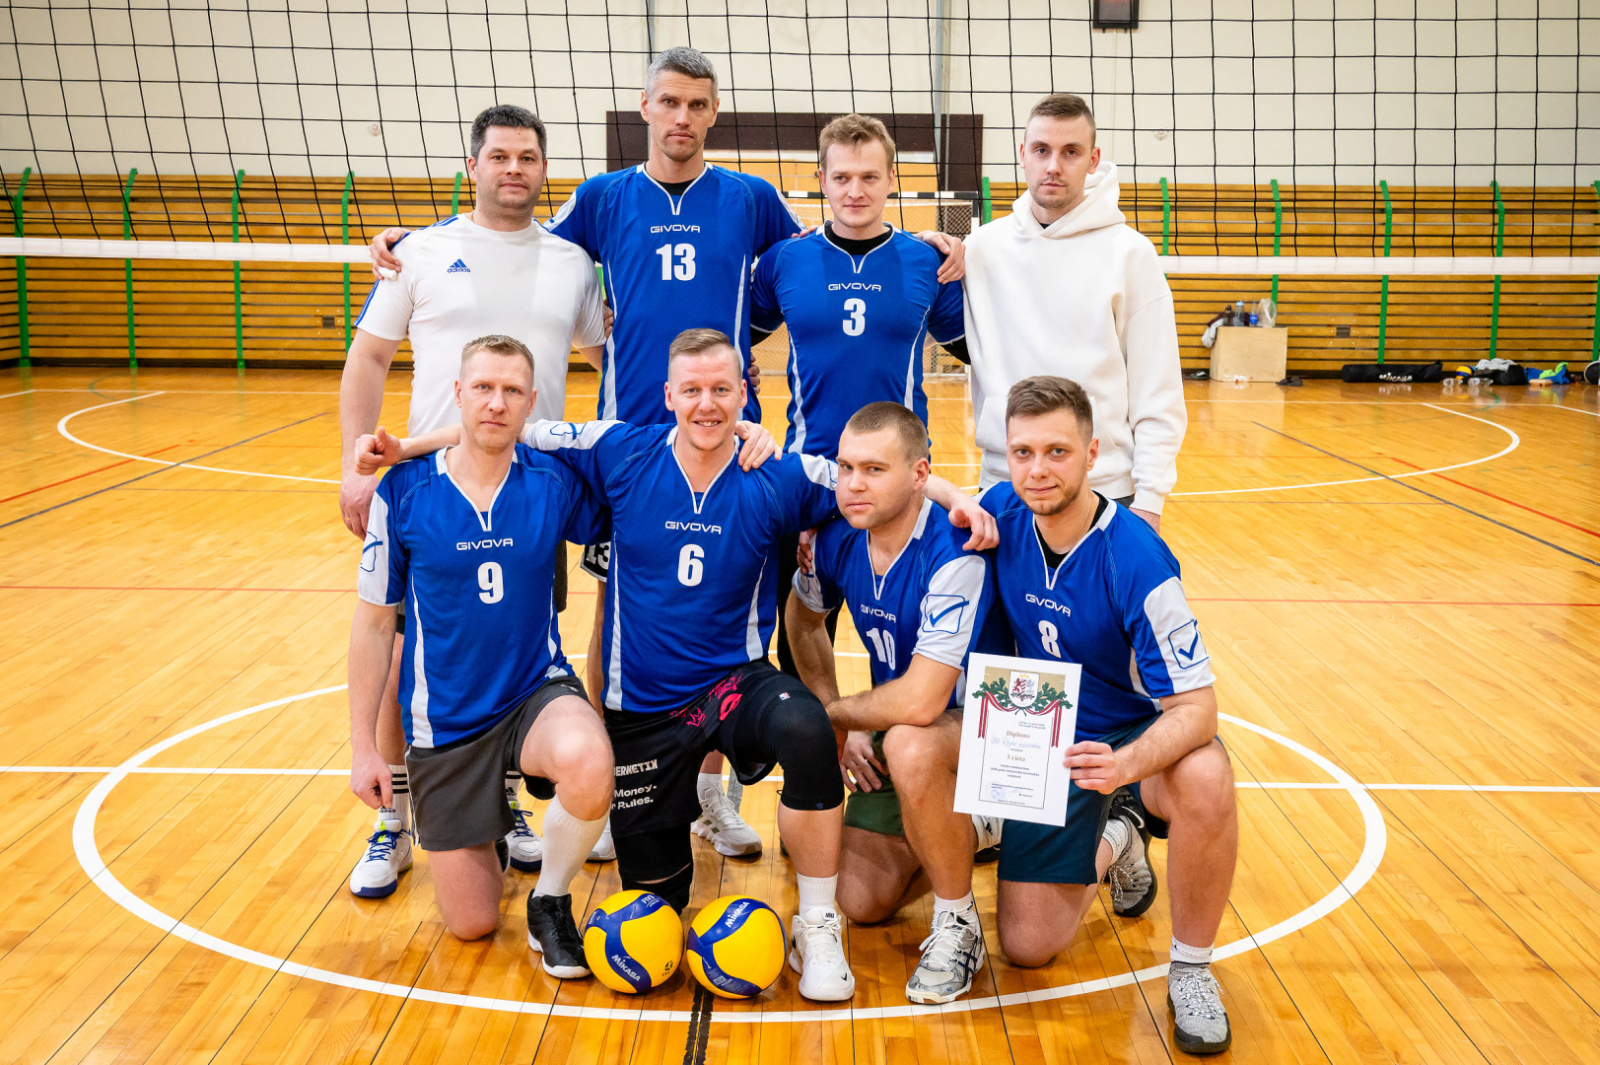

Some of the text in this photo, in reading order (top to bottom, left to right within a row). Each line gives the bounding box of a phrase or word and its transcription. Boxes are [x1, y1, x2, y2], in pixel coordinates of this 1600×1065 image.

[650, 224, 701, 234] GIVOVA
[656, 243, 696, 281] 13
[828, 282, 882, 292] GIVOVA
[842, 298, 866, 336] 3
[664, 521, 722, 535] GIVOVA
[456, 538, 513, 551] GIVOVA
[677, 543, 705, 587] 6
[477, 561, 504, 604] 9
[860, 604, 897, 624] GIVOVA
[1025, 593, 1071, 618] GVOVA
[865, 627, 896, 671] 10
[1038, 620, 1062, 659] 8
[614, 784, 657, 798] Money.
[618, 797, 654, 810] Rules.
